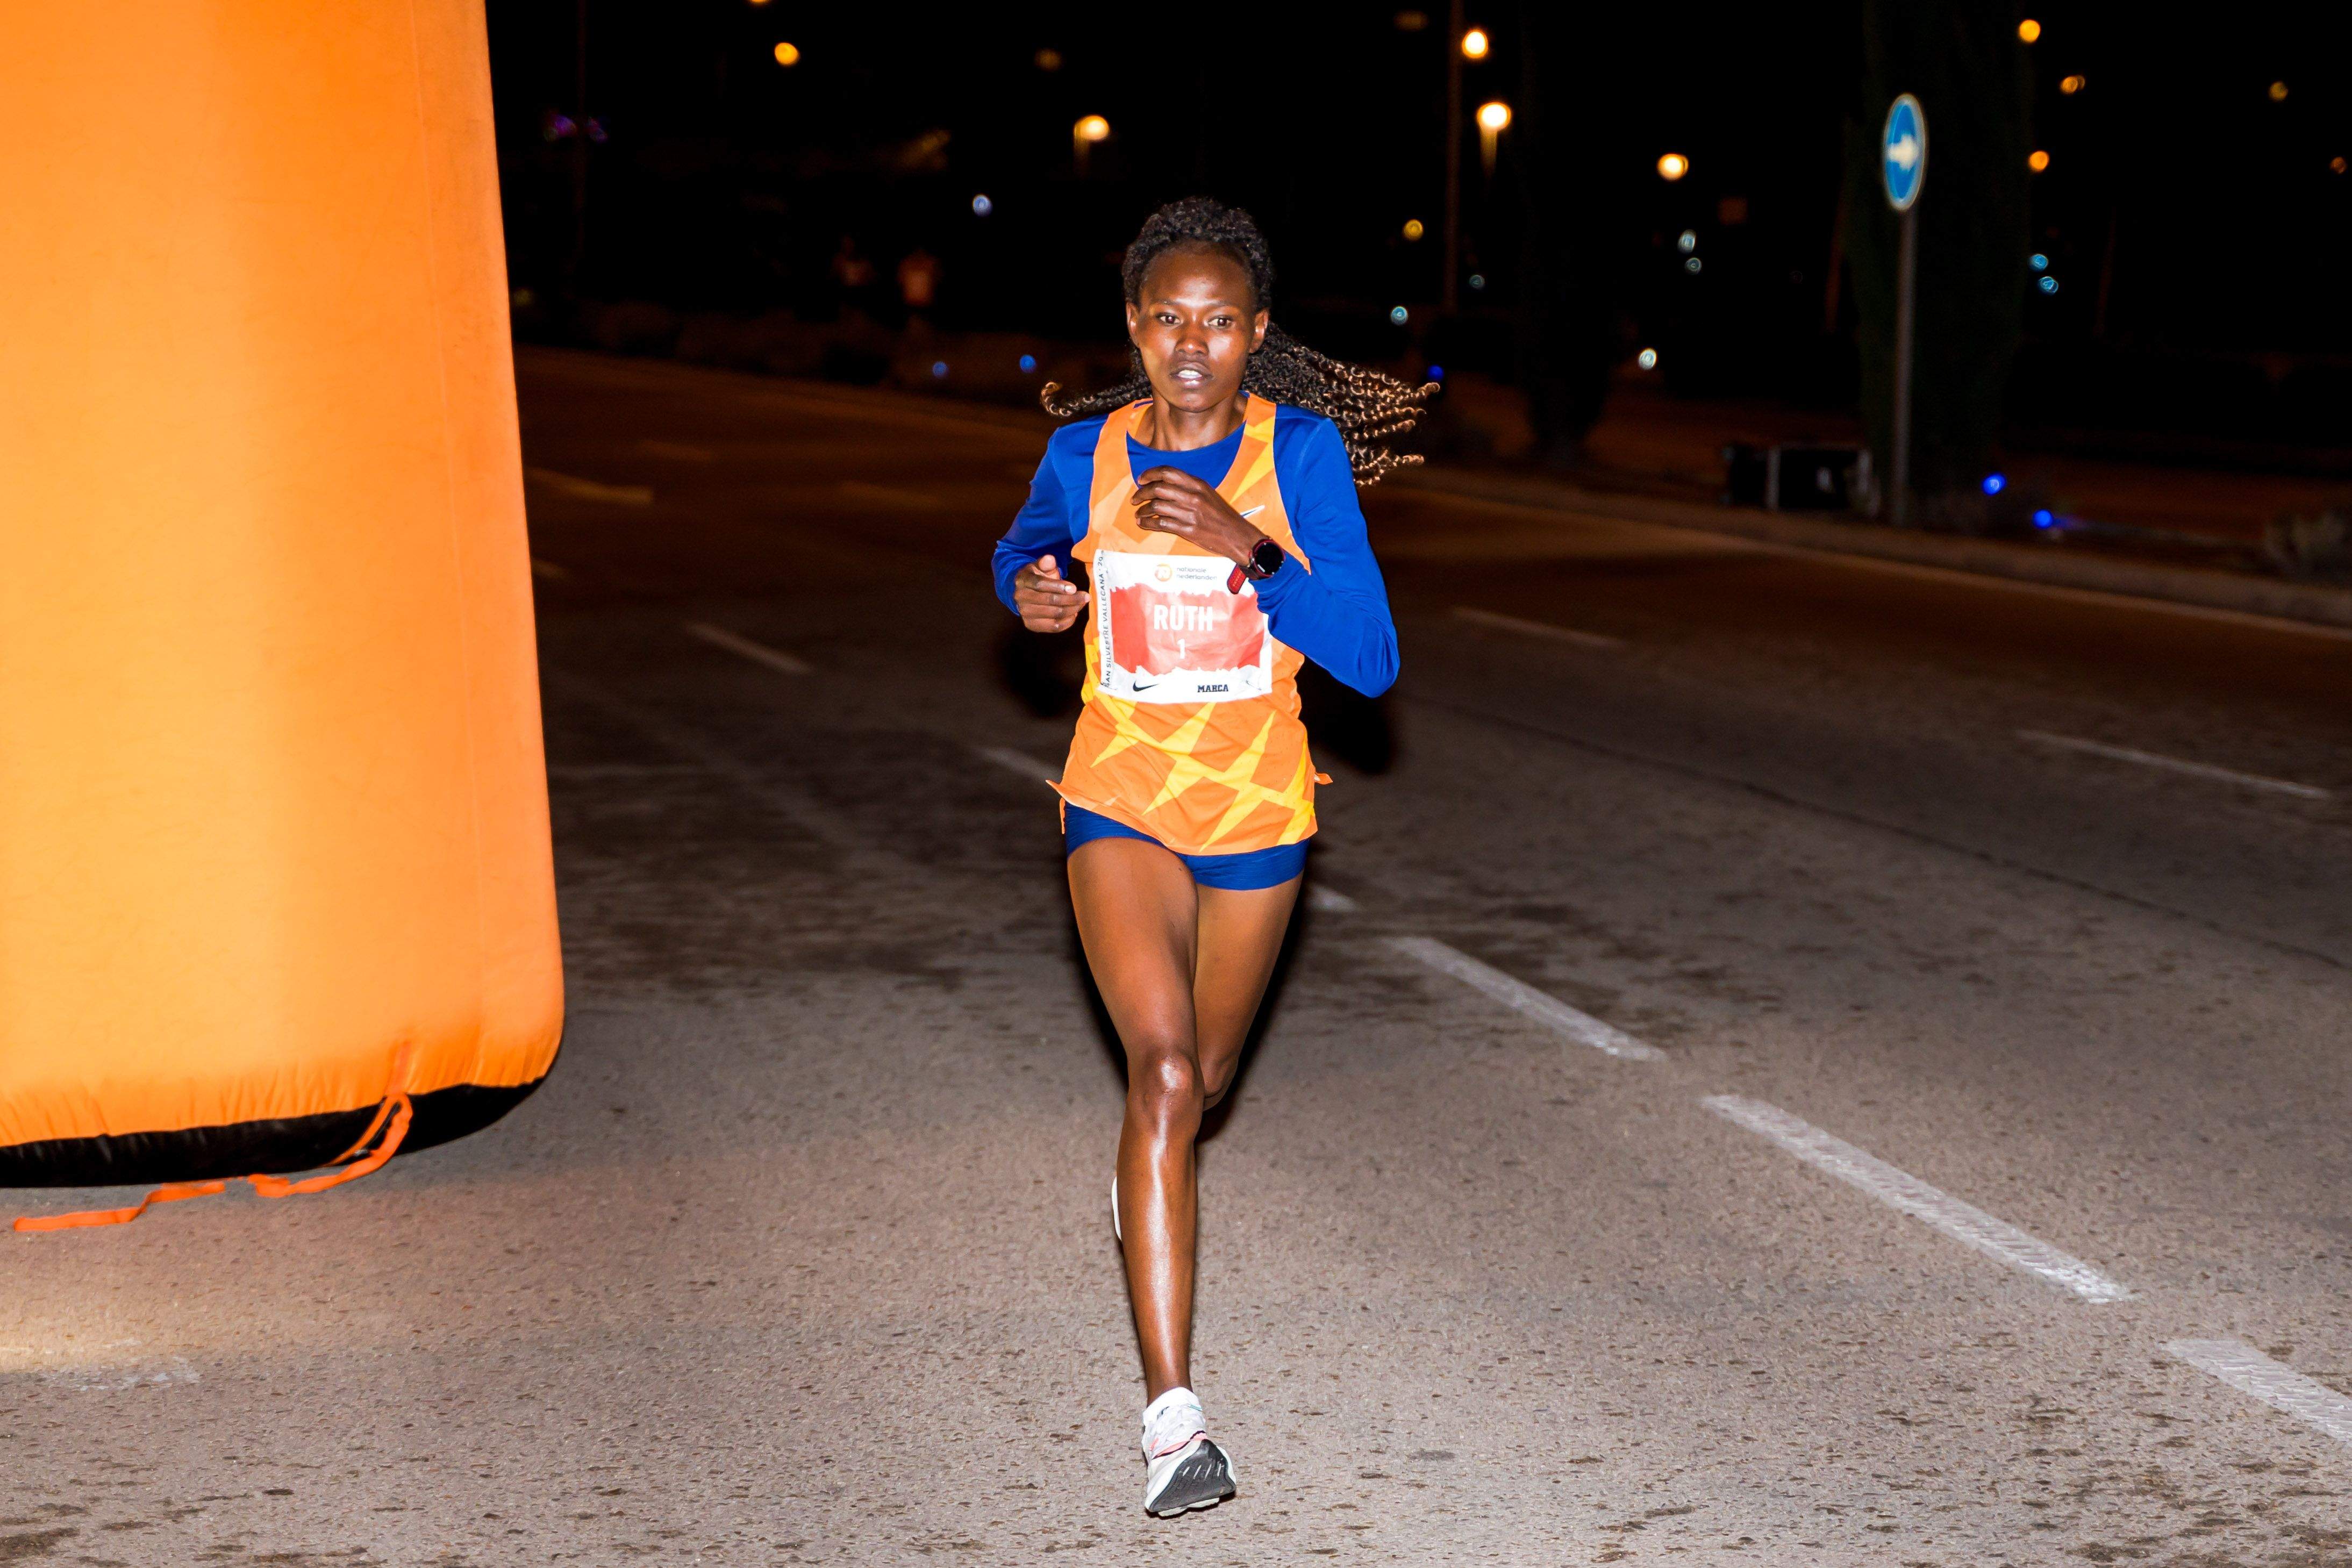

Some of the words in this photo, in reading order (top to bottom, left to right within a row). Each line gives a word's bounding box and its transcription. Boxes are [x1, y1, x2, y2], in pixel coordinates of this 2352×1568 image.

[1098, 574, 1107, 622] VALLECANA
[1154, 604, 1213, 631] RUTH
[1103, 625, 1111, 668] SILVESTRE
[1177, 639, 1185, 659] 1
[1197, 684, 1228, 692] MARCA
